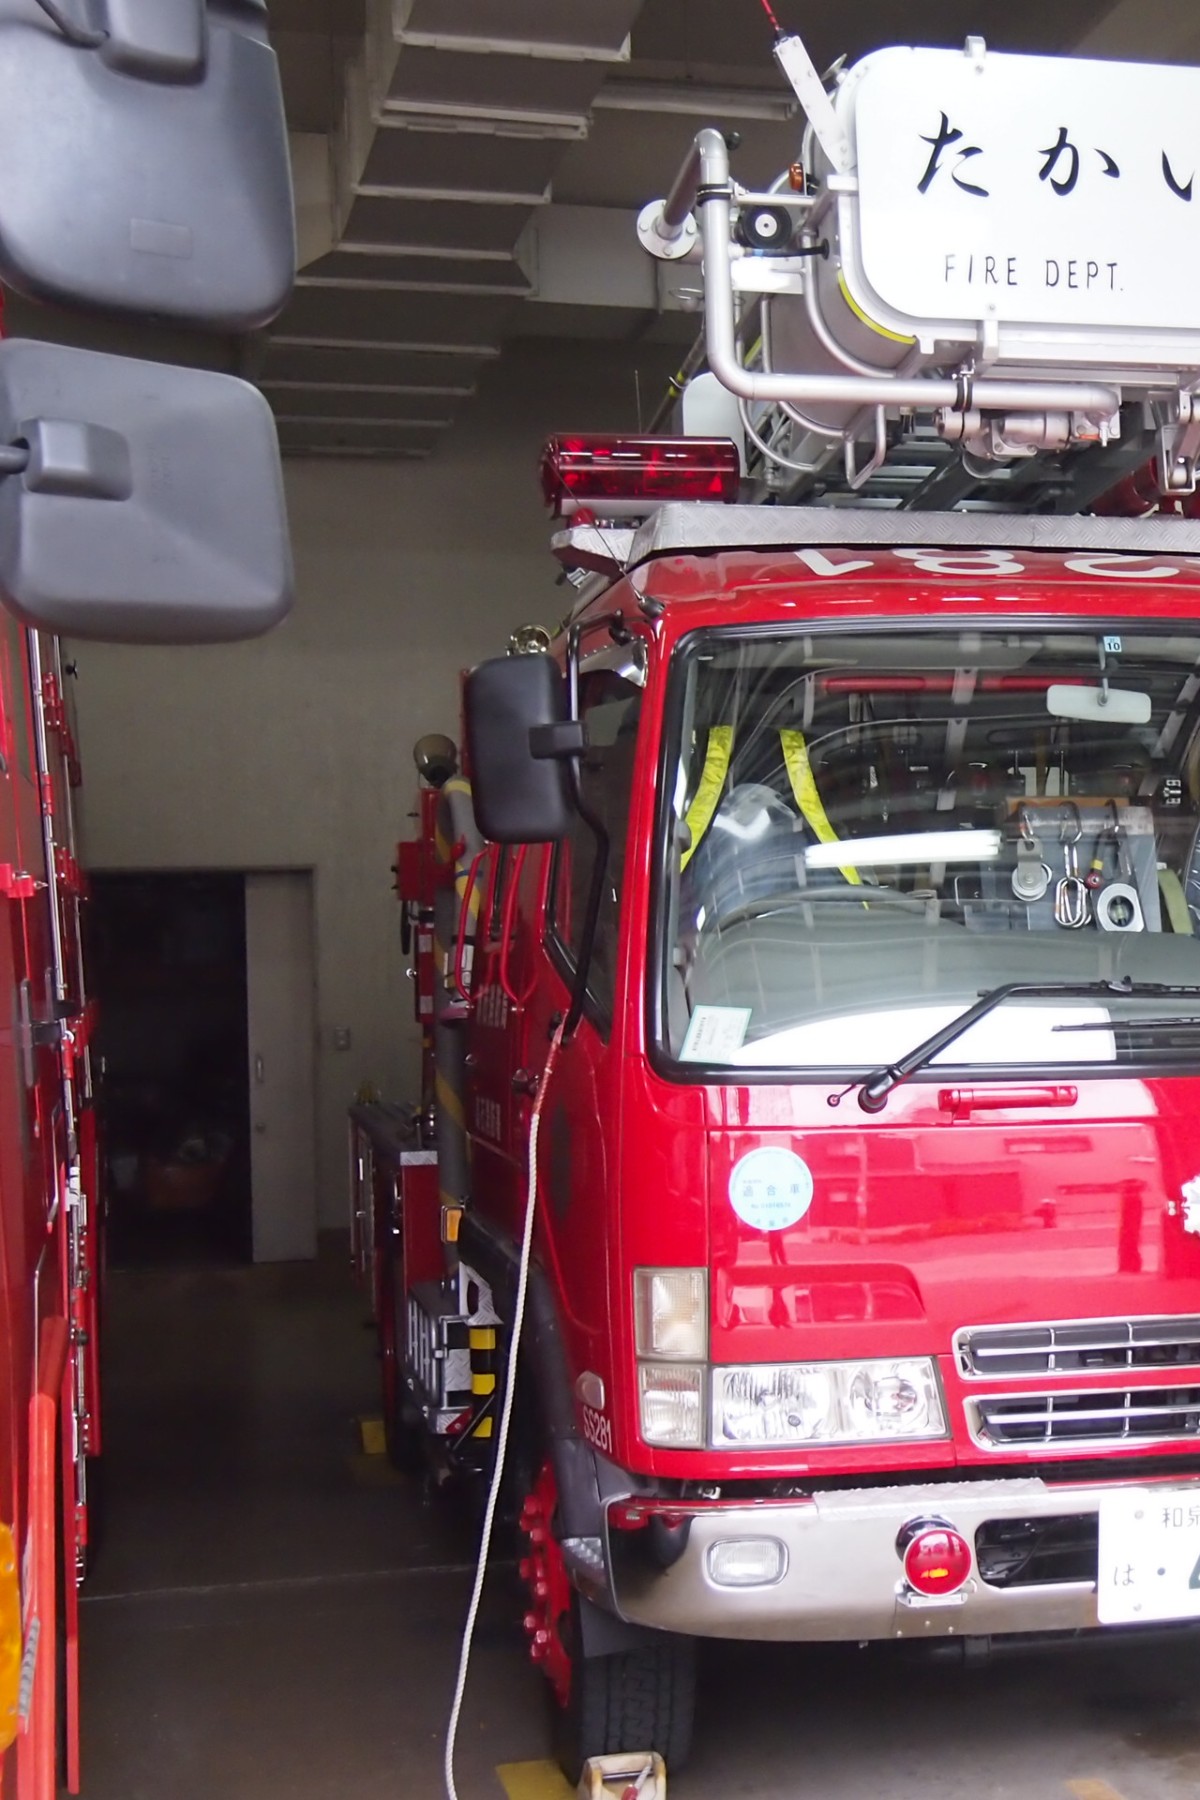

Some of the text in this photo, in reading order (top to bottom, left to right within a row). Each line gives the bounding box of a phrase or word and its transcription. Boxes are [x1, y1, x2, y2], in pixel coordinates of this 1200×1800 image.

[945, 254, 1124, 291] FIRE DEPT.
[1107, 642, 1121, 651] 10
[583, 1404, 612, 1454] SS281
[1113, 1564, 1135, 1587] は
